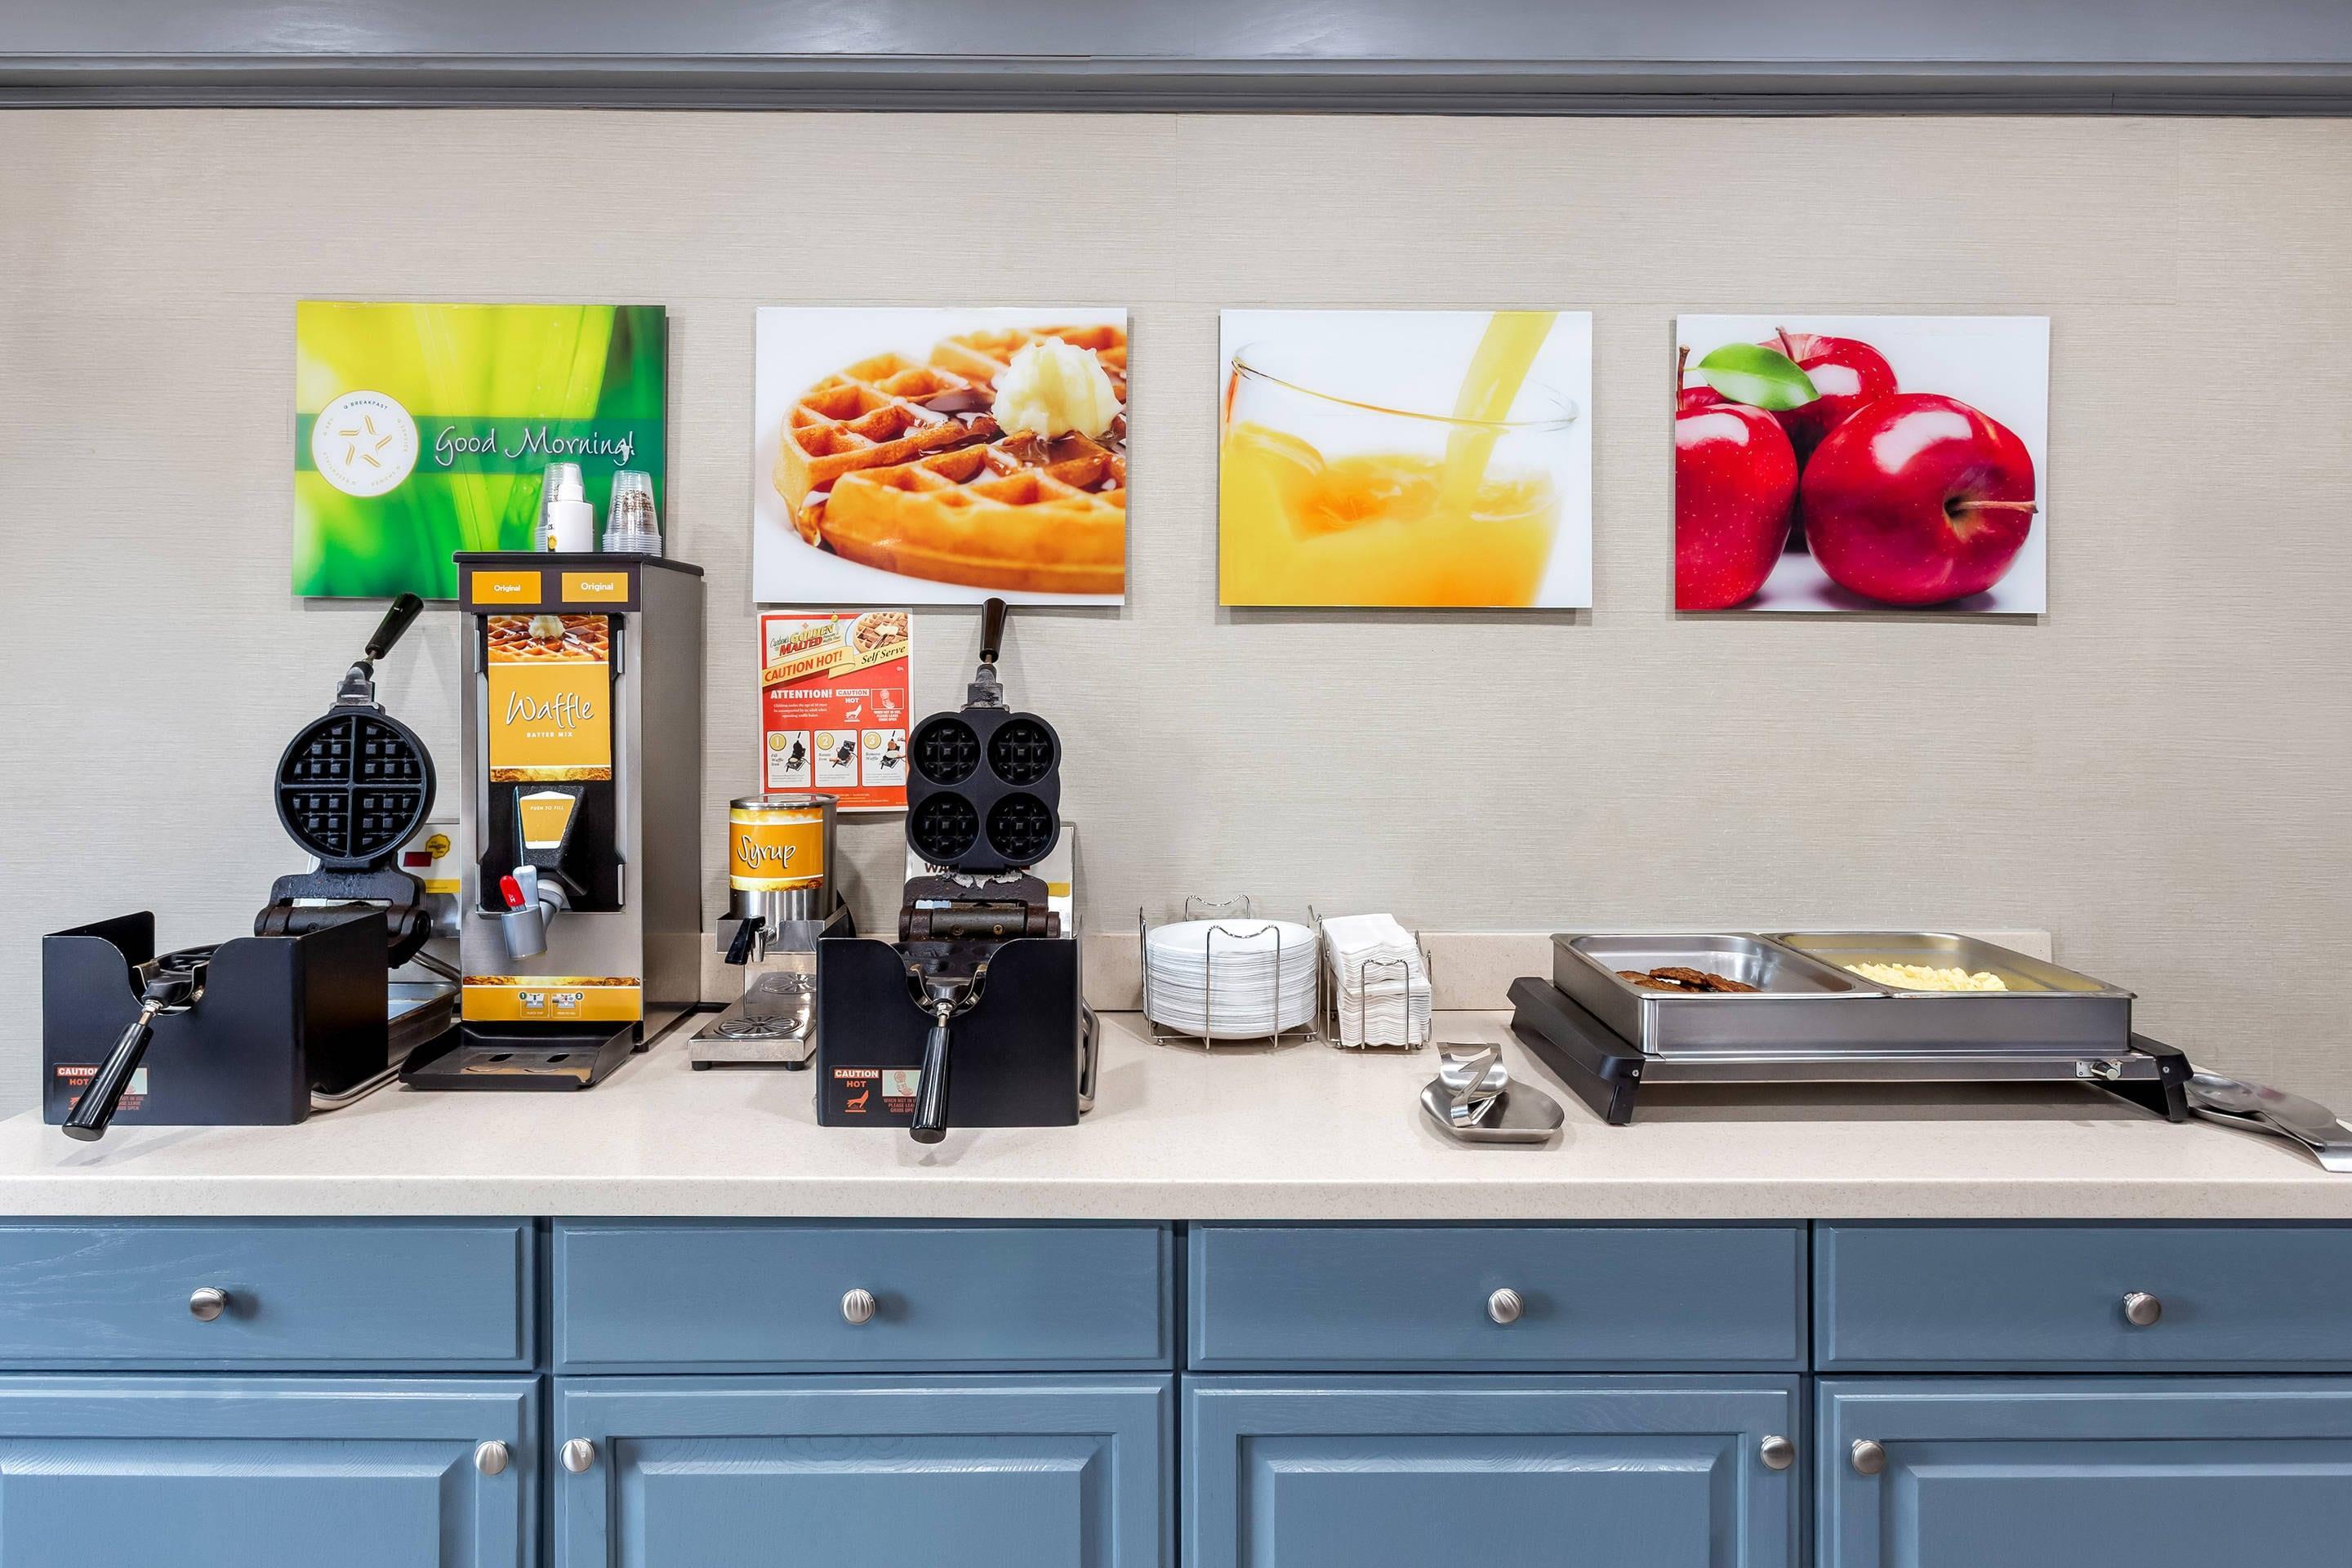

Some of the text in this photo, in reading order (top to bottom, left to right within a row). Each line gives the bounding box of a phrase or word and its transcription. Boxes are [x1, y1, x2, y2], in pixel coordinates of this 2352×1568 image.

[350, 400, 388, 410] BREAKFAST
[434, 425, 635, 467] Good Morning!
[493, 584, 521, 593] Original
[581, 582, 614, 592] Original
[790, 623, 835, 644] GOLDEN
[779, 636, 823, 657] MALTED
[861, 646, 906, 665] Self Serve
[764, 650, 843, 682] CAUTION HOT!
[770, 689, 833, 699] ATTENTION!
[506, 691, 595, 729] Waffle
[822, 737, 829, 746] 2
[869, 736, 875, 746] 3
[737, 835, 796, 869] Syrup
[835, 1070, 879, 1078] CAUTION
